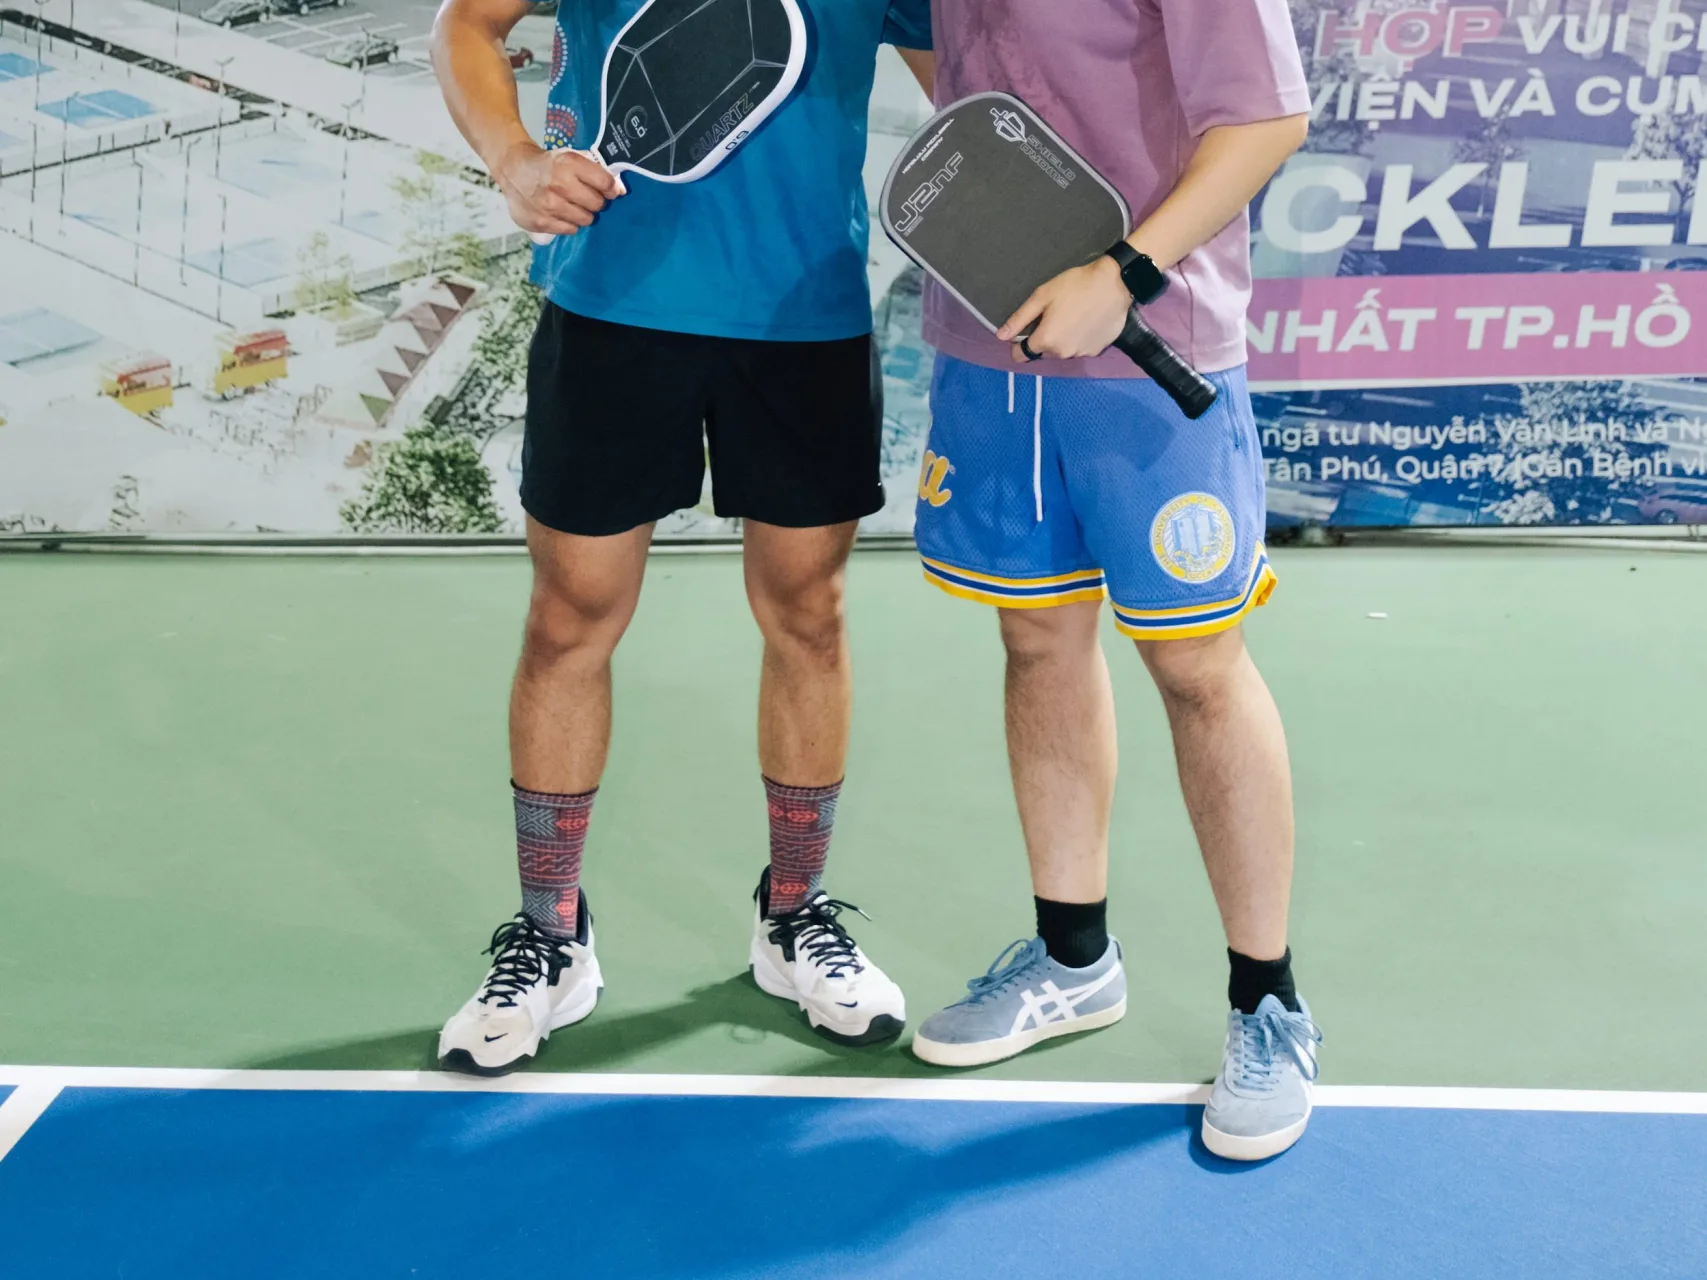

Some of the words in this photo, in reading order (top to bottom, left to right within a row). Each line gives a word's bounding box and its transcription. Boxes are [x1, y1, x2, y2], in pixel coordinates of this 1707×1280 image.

[1313, 0, 1504, 71] HỢP
[1517, 13, 1631, 55] VUI
[1648, 12, 1707, 53] C
[1469, 68, 1556, 117] VÀ
[631, 115, 646, 138] 6.0
[689, 92, 755, 161] QUARTZ
[1027, 134, 1076, 181] SHIELD
[1261, 160, 1707, 254] CKLE
[1454, 283, 1691, 350] TP.HỒ
[1263, 421, 1320, 452] ngã
[1327, 423, 1362, 446] tư
[1368, 415, 1487, 450] Nguyễn
[1320, 455, 1389, 482] Phú,
